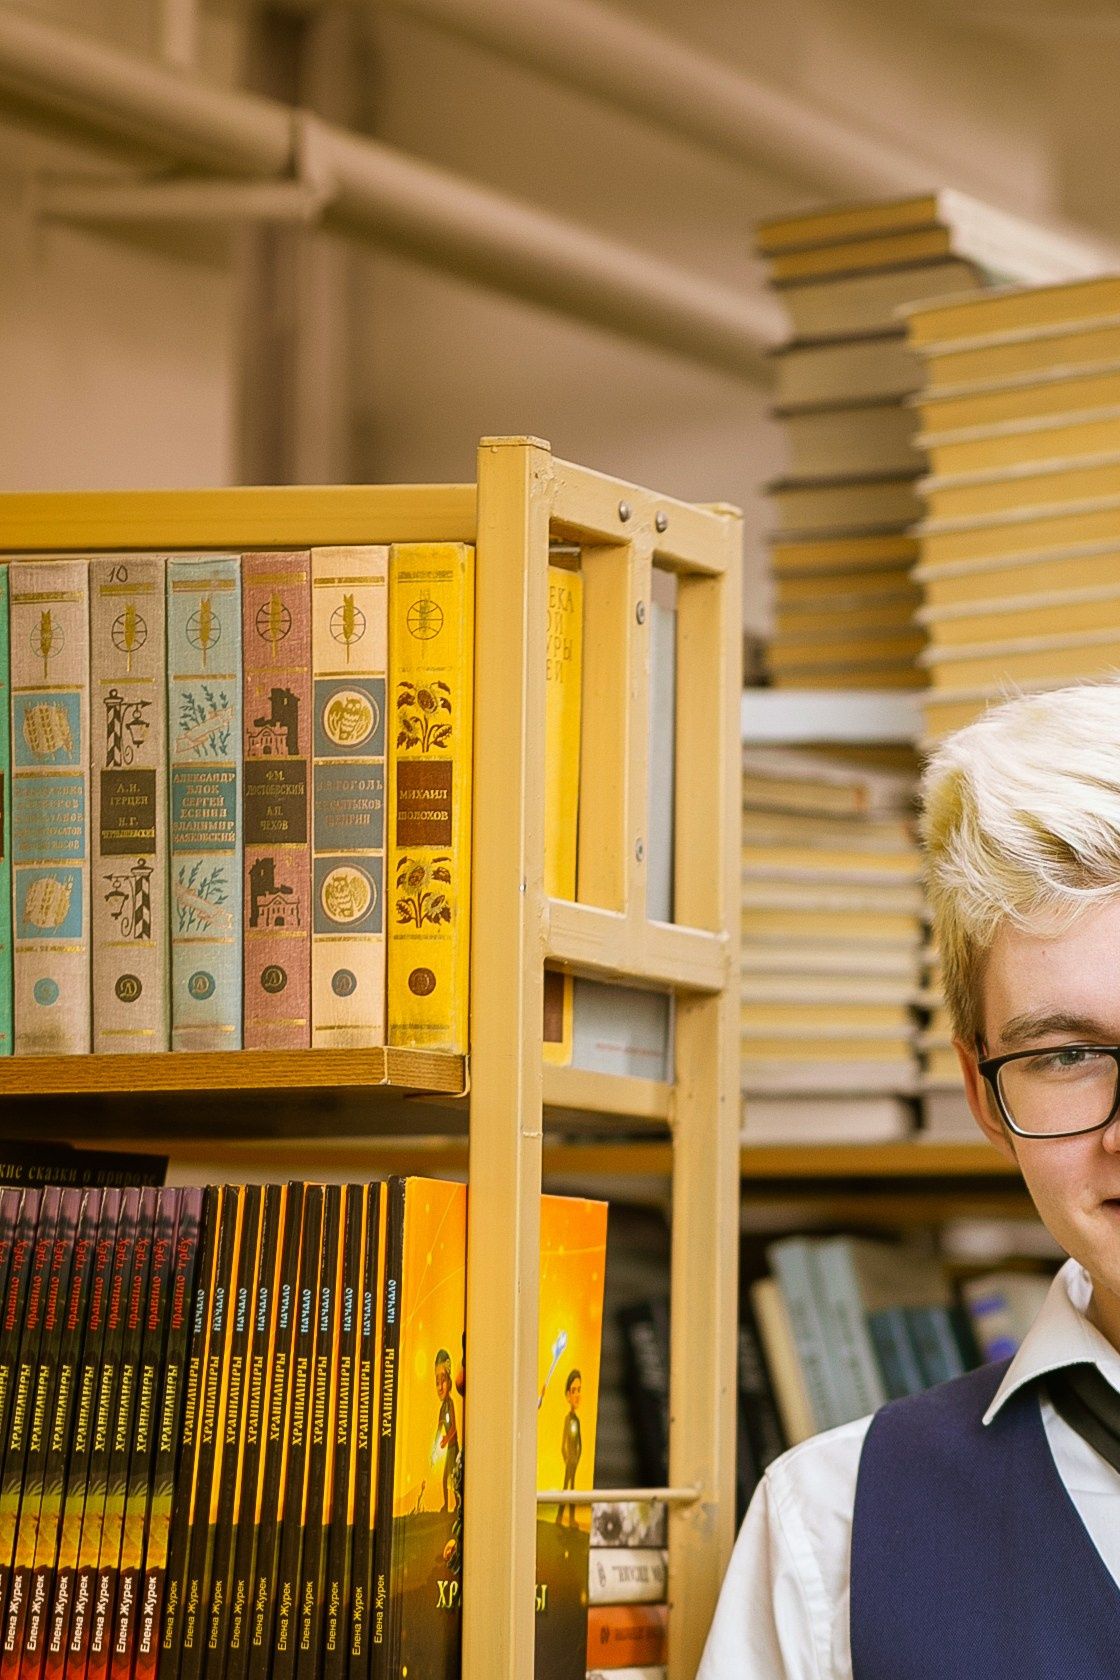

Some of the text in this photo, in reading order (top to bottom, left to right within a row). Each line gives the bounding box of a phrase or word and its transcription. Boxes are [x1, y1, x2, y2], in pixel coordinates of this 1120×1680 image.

[107, 565, 129, 582] 10
[110, 795, 149, 806] ГЕРЦЕН
[173, 772, 236, 783] АЛЕКСАНДР
[180, 808, 227, 819] ЕСЕНИН
[182, 795, 225, 807] СЕРГЕЙ
[186, 785, 220, 795] БЛОК
[246, 782, 305, 797] ДОСТОЕВСКИЙ
[399, 789, 448, 801] МИХАИЛ
[172, 821, 235, 832] ВЛАДИМИР
[172, 830, 236, 843] МАЯКОВСКИЙ
[260, 819, 289, 831] ЧЕХОВ
[397, 811, 449, 822] ШОЛОХОВ
[28, 1166, 77, 1183] сказки
[83, 1169, 91, 1182] о
[11, 1363, 31, 1452] ХРАНИМИРЫ
[31, 1365, 50, 1453] ХРАНИМИРЫ
[52, 1364, 72, 1452] ХРАНИМИРЫ
[76, 1365, 95, 1453] ХРАНИМИРЫ
[95, 1364, 114, 1452] ХРАНИМИРЫ
[116, 1364, 134, 1452] ХРАНИМИРЫ
[137, 1365, 154, 1453] ХРАНИМИРЫ
[161, 1364, 178, 1453] ХРАНИМИРЫ
[182, 1357, 200, 1446] ХРАНИМИРЫ
[202, 1355, 220, 1445] ХРАНИМИРЫ
[226, 1356, 243, 1445] ХРАНИМИРЫ
[247, 1356, 264, 1445] ХРАНИМИРЫ
[270, 1352, 286, 1442] ХРАНИМИРЫ
[291, 1357, 308, 1446] ХРАНИМИРЫ
[313, 1356, 328, 1445] ХРАНИМИРЫ
[337, 1356, 351, 1445] ХРАНИМИРЫ
[358, 1360, 371, 1450] ХРАНИМИРЫ
[382, 1348, 395, 1437] ХРАНИМИРЫ
[4, 1574, 23, 1652] Елена Журек
[27, 1574, 45, 1651] Елена Журек
[50, 1575, 69, 1652] Елена Журек
[70, 1574, 89, 1652] Елена Журек
[91, 1575, 110, 1652] Елена Журек
[116, 1576, 133, 1653] Елена Журек
[140, 1576, 157, 1653] Елена Журек
[163, 1580, 178, 1649] Елена Журек
[184, 1579, 199, 1648] Елена Журек
[209, 1580, 223, 1649] Елена Журек
[231, 1580, 245, 1648] Елена Журек
[253, 1577, 268, 1646] Елена Журек
[278, 1582, 292, 1651] Елена Журек
[300, 1580, 314, 1650] Елена Журек
[327, 1581, 340, 1651] Елена Журек
[352, 1586, 364, 1656] Елена Журек
[374, 1574, 386, 1644] Елена Журек
